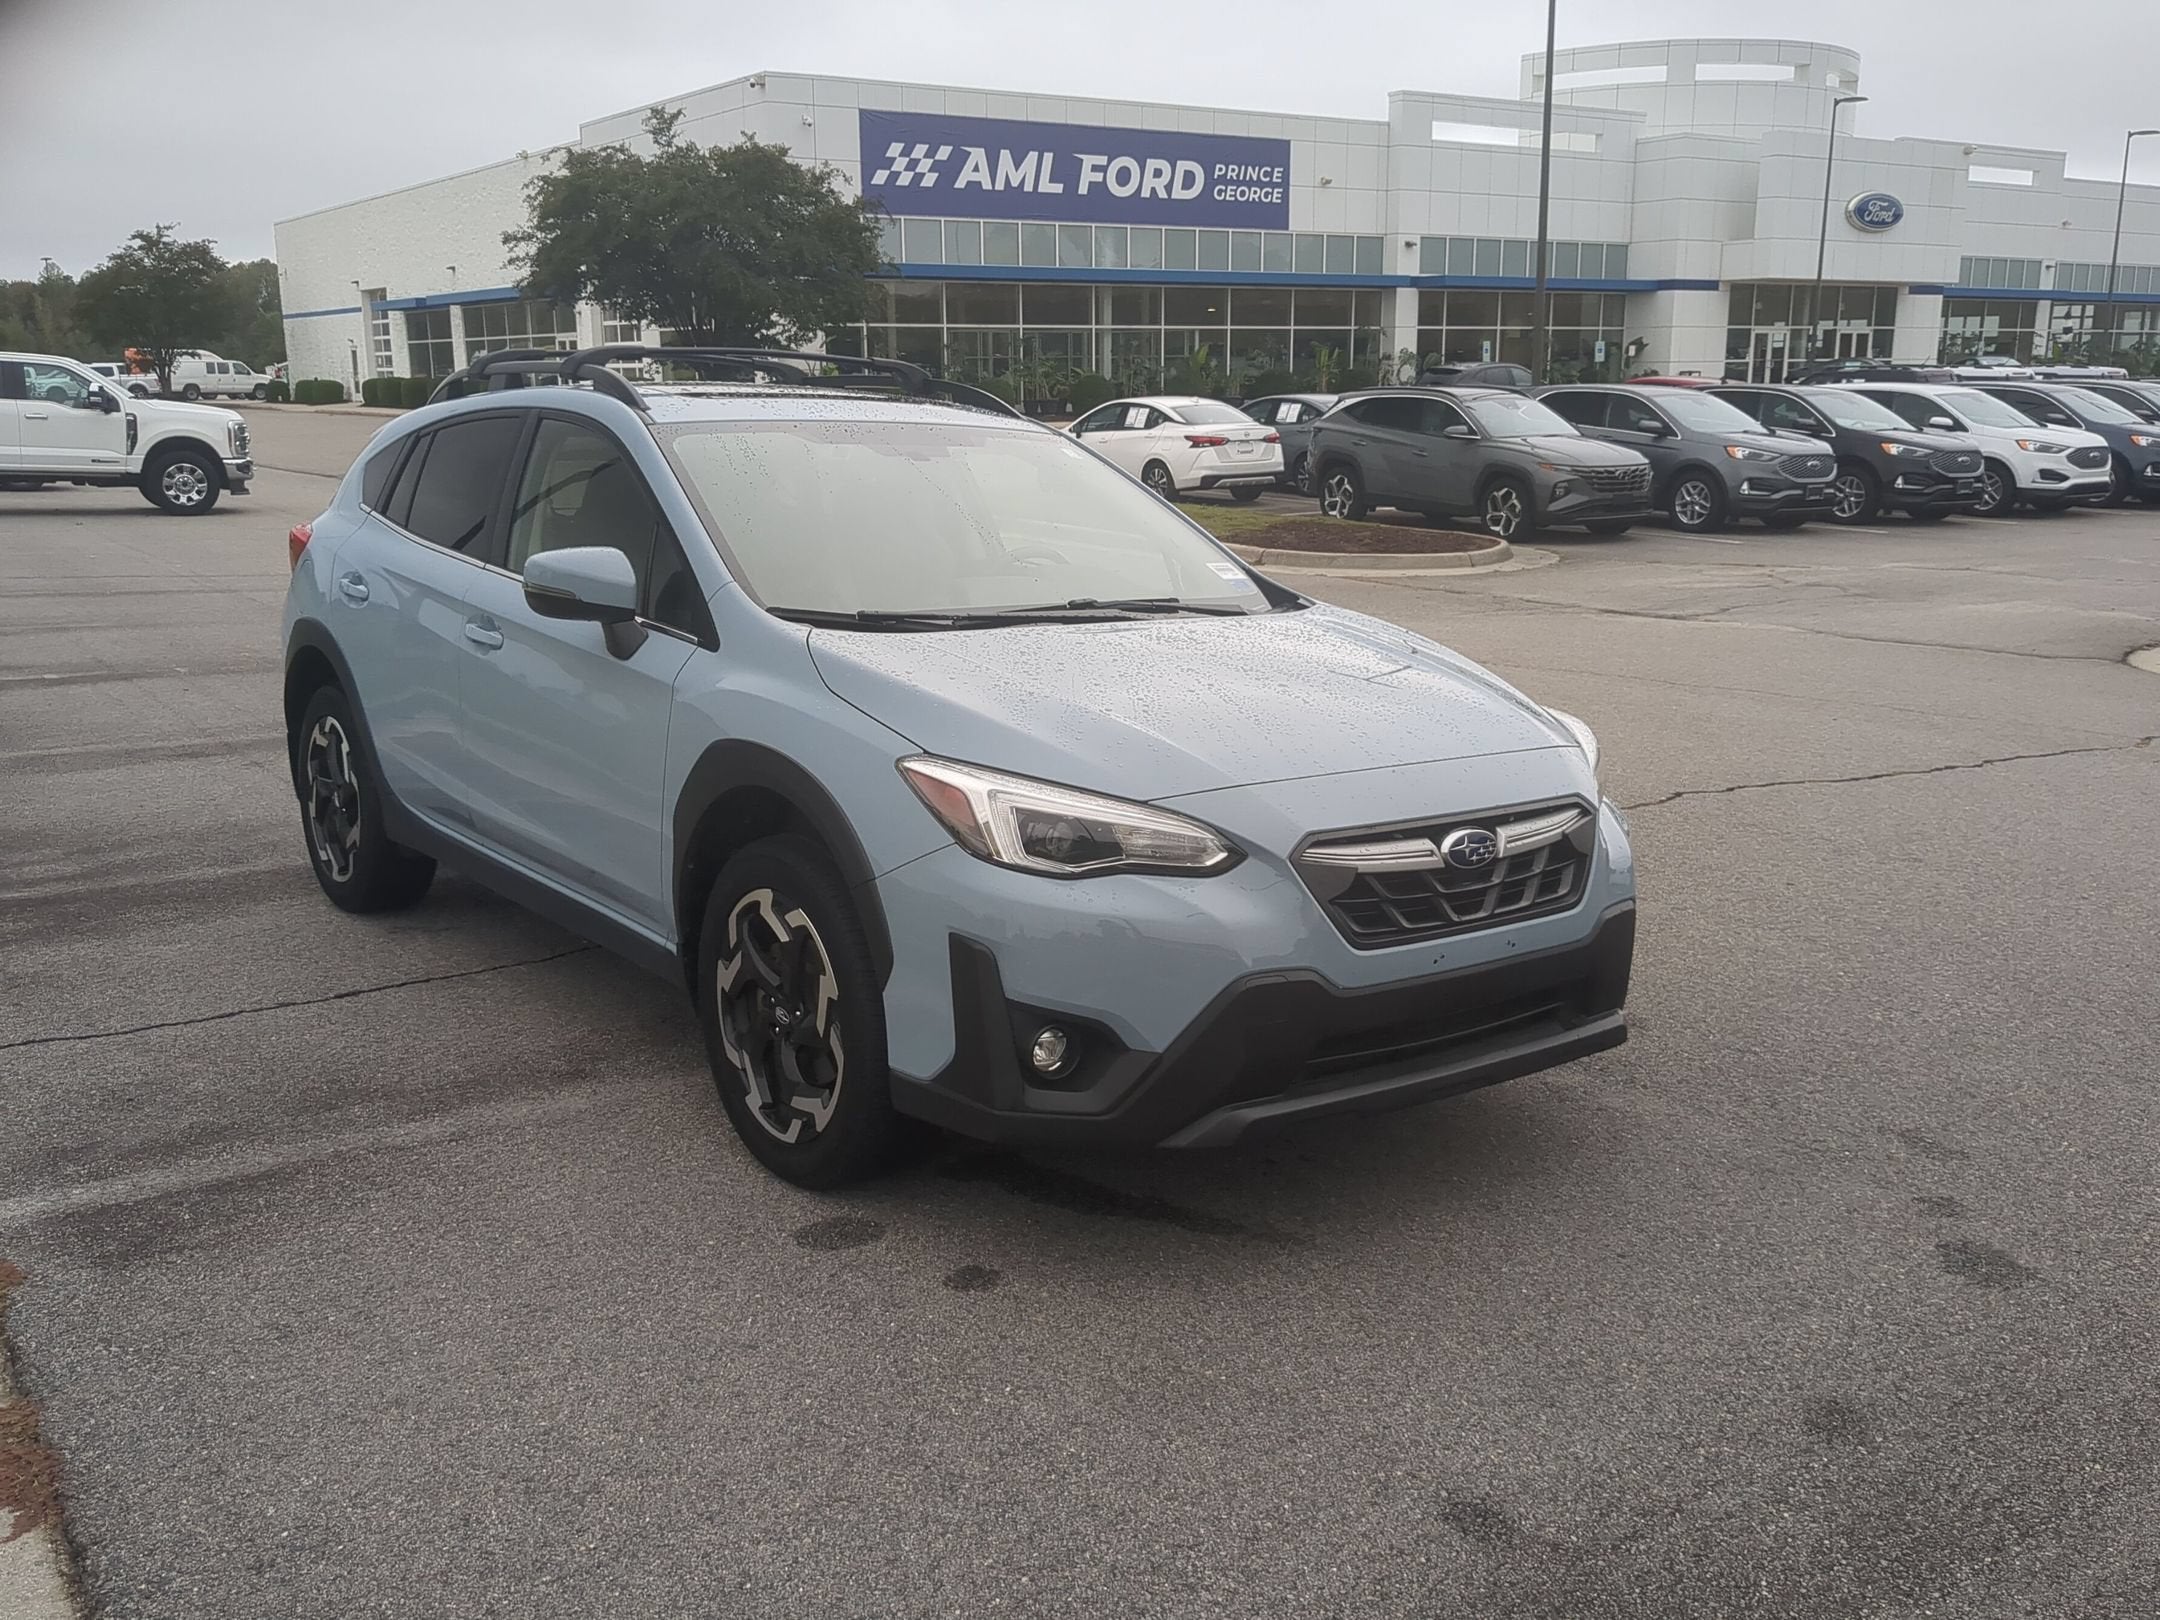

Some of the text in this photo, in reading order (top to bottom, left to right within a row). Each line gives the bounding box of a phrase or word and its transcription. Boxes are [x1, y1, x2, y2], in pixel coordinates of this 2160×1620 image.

[953, 146, 1205, 200] AML FORD
[1214, 164, 1283, 182] PRINCE
[1213, 185, 1283, 203] GEORGE
[1864, 200, 1896, 222] Ford
